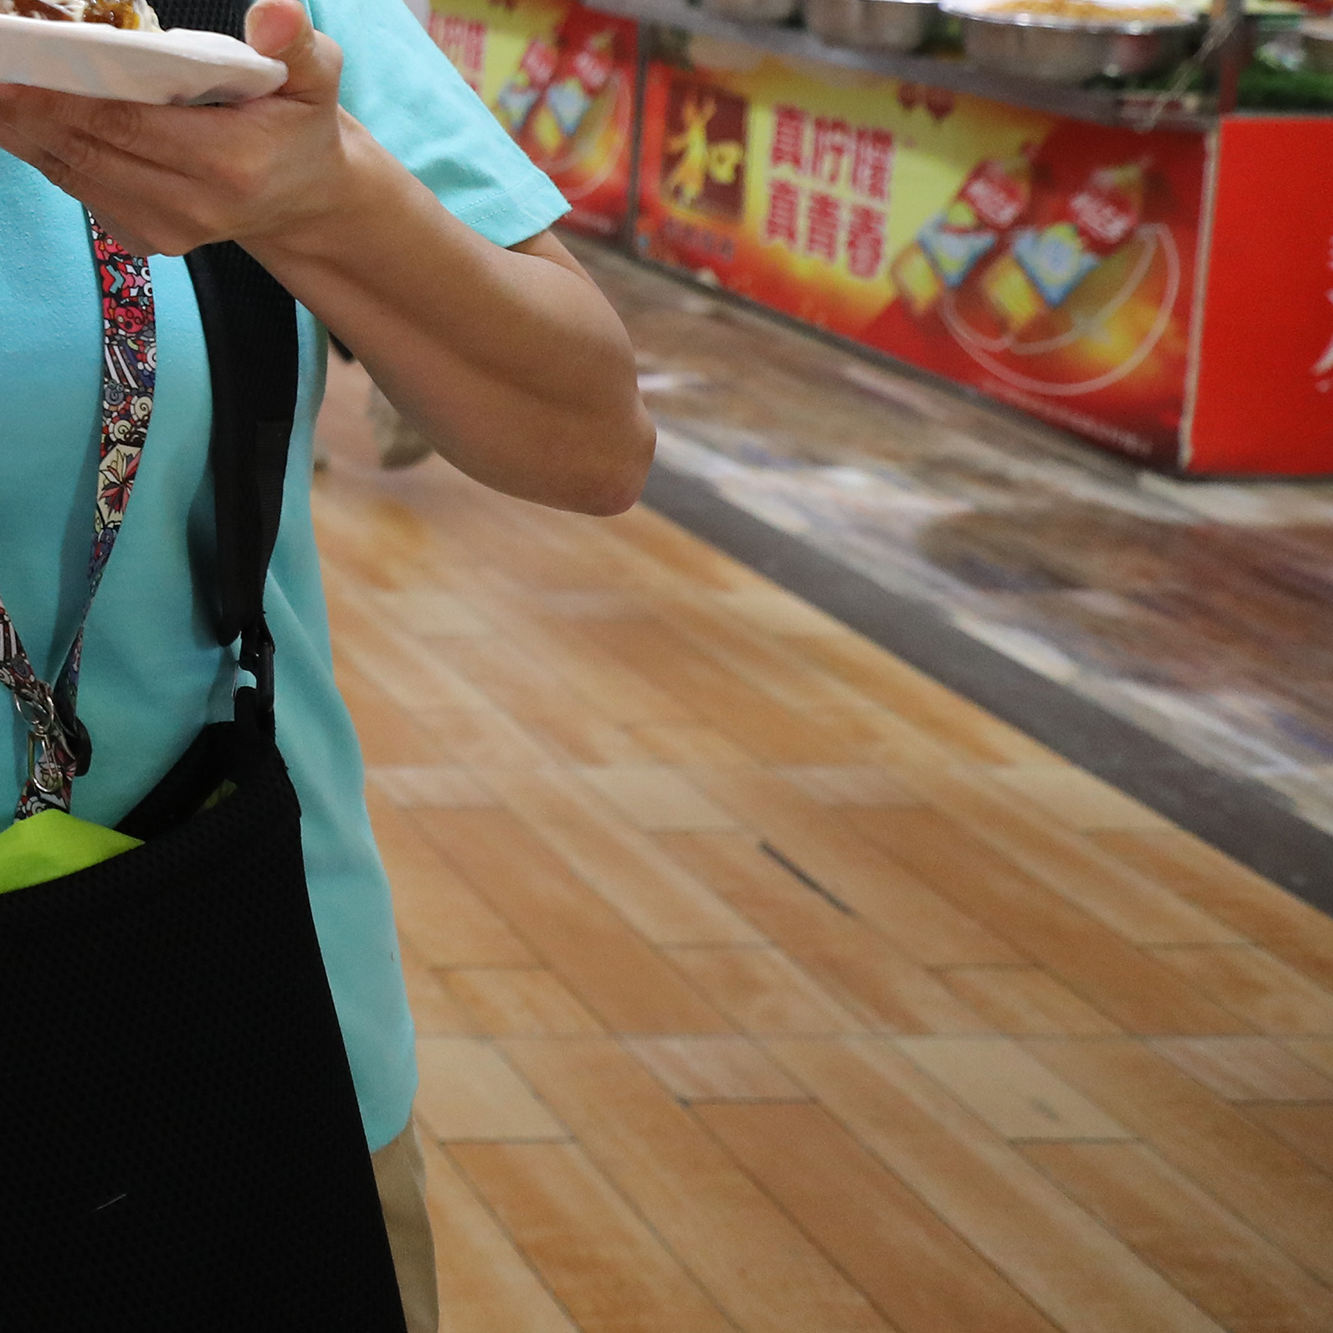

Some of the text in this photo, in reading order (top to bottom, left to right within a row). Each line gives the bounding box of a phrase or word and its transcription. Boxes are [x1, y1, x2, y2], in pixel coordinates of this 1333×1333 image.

[771, 104, 895, 201] 真柠檬
[766, 178, 886, 279] 真青春
